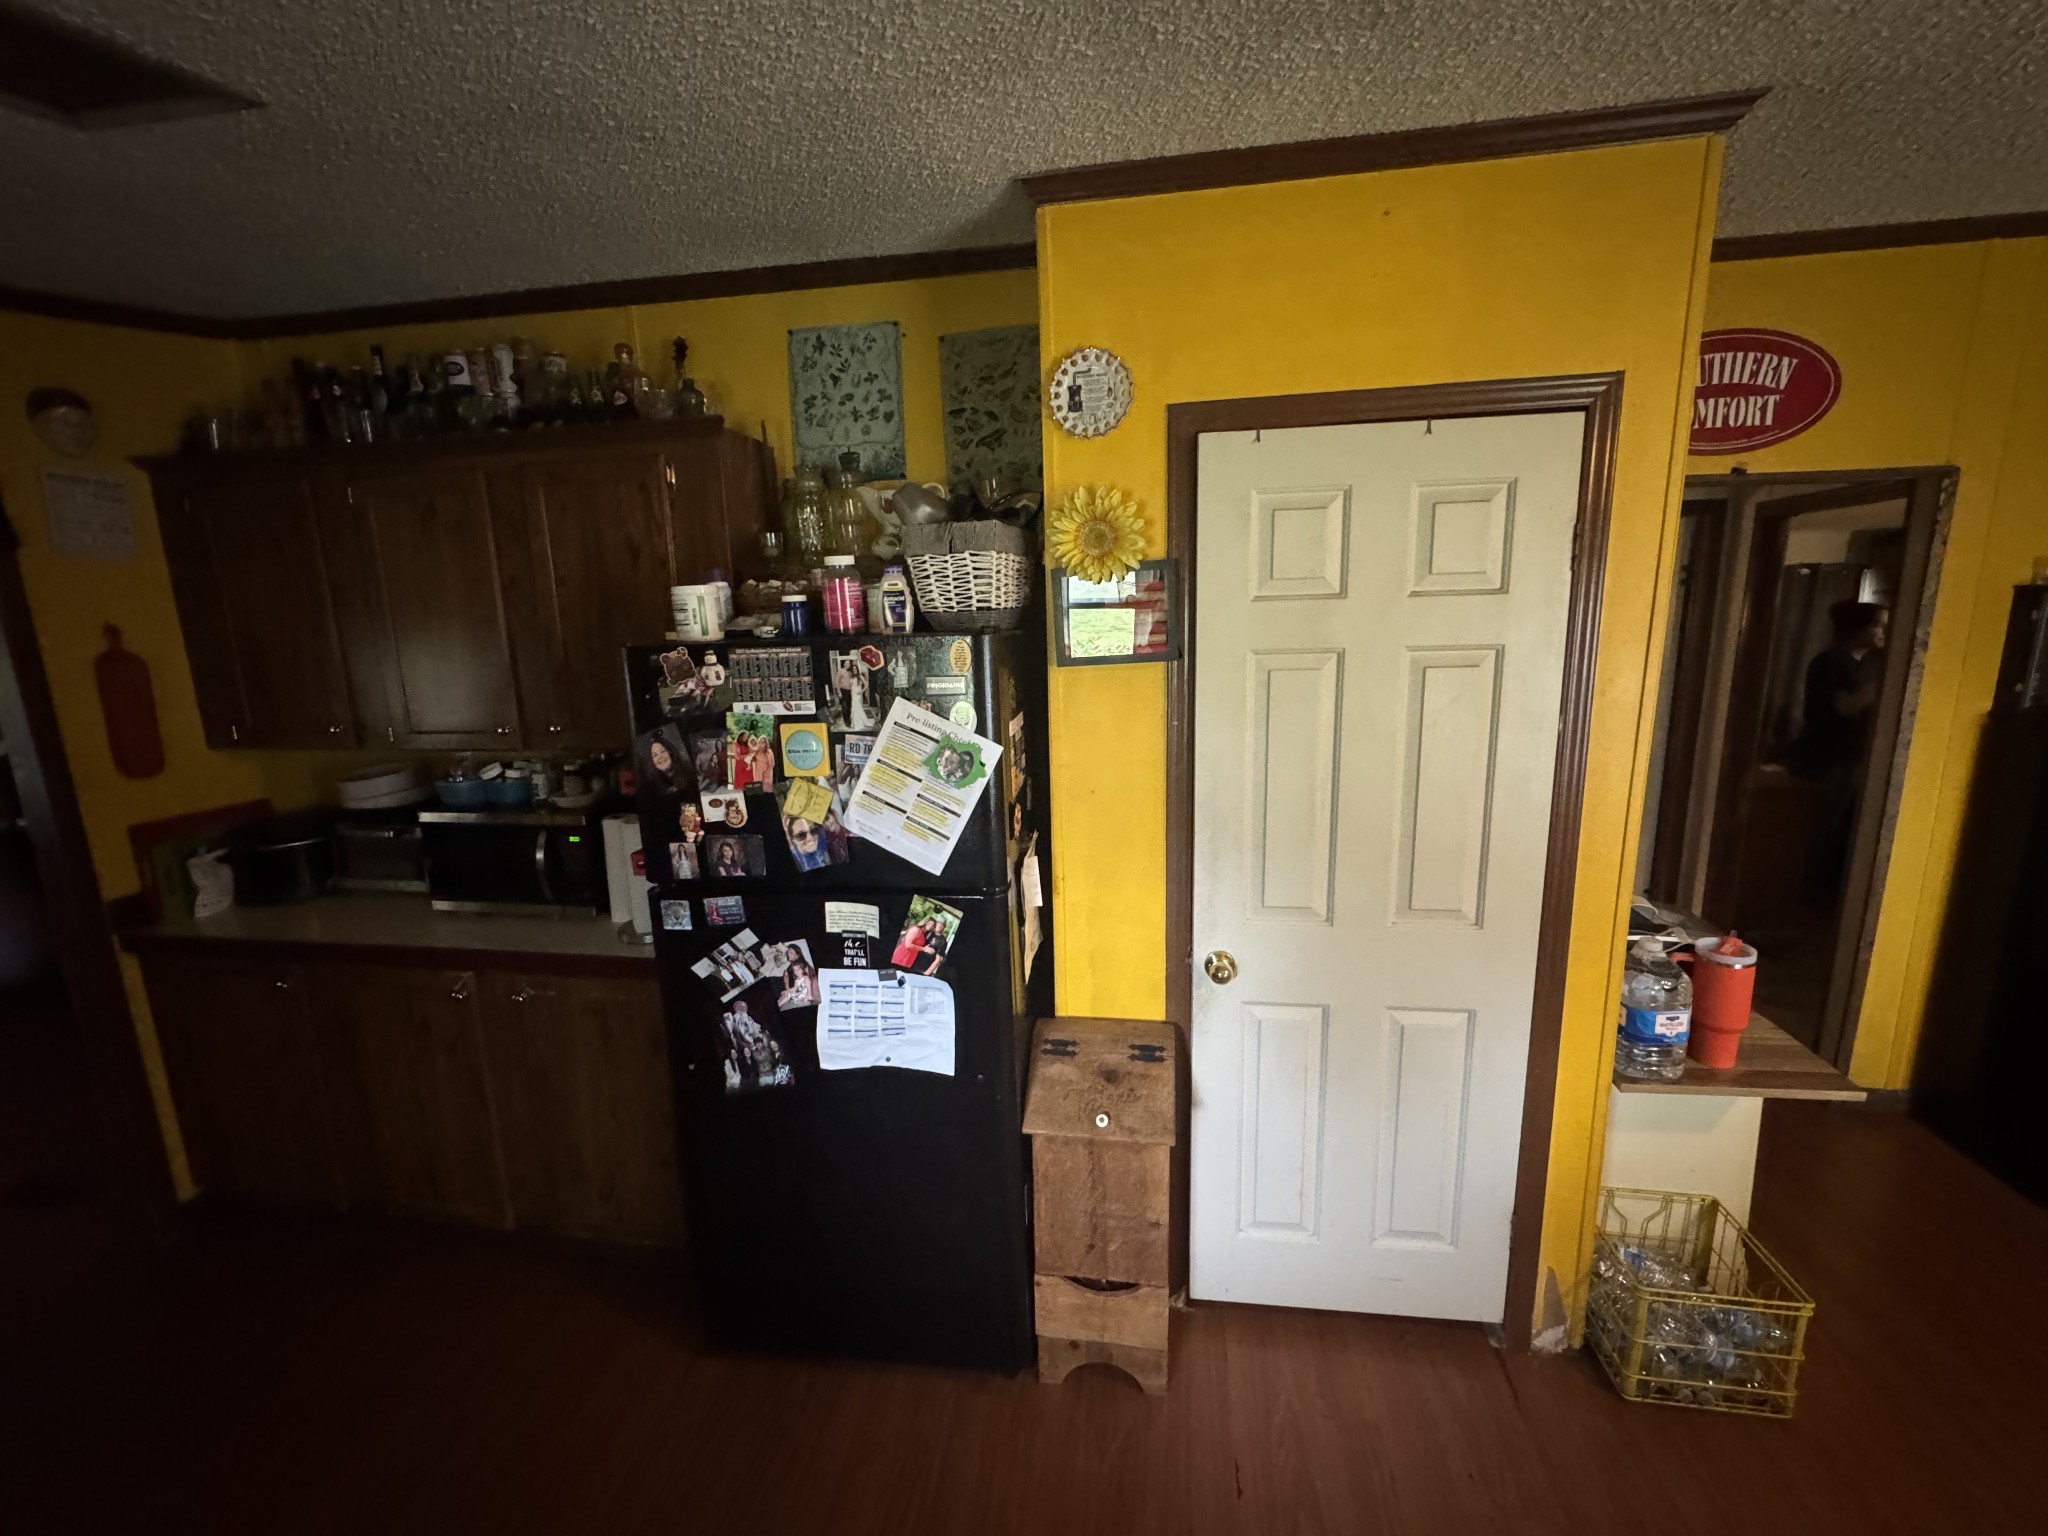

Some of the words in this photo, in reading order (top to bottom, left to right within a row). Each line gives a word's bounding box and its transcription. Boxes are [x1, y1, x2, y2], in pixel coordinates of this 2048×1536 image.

[1697, 351, 1799, 391] UTHERN
[1692, 394, 1781, 430] MFORT
[906, 712, 948, 736] Pre-listing
[843, 956, 853, 966] BE
[853, 957, 867, 967] FUN
